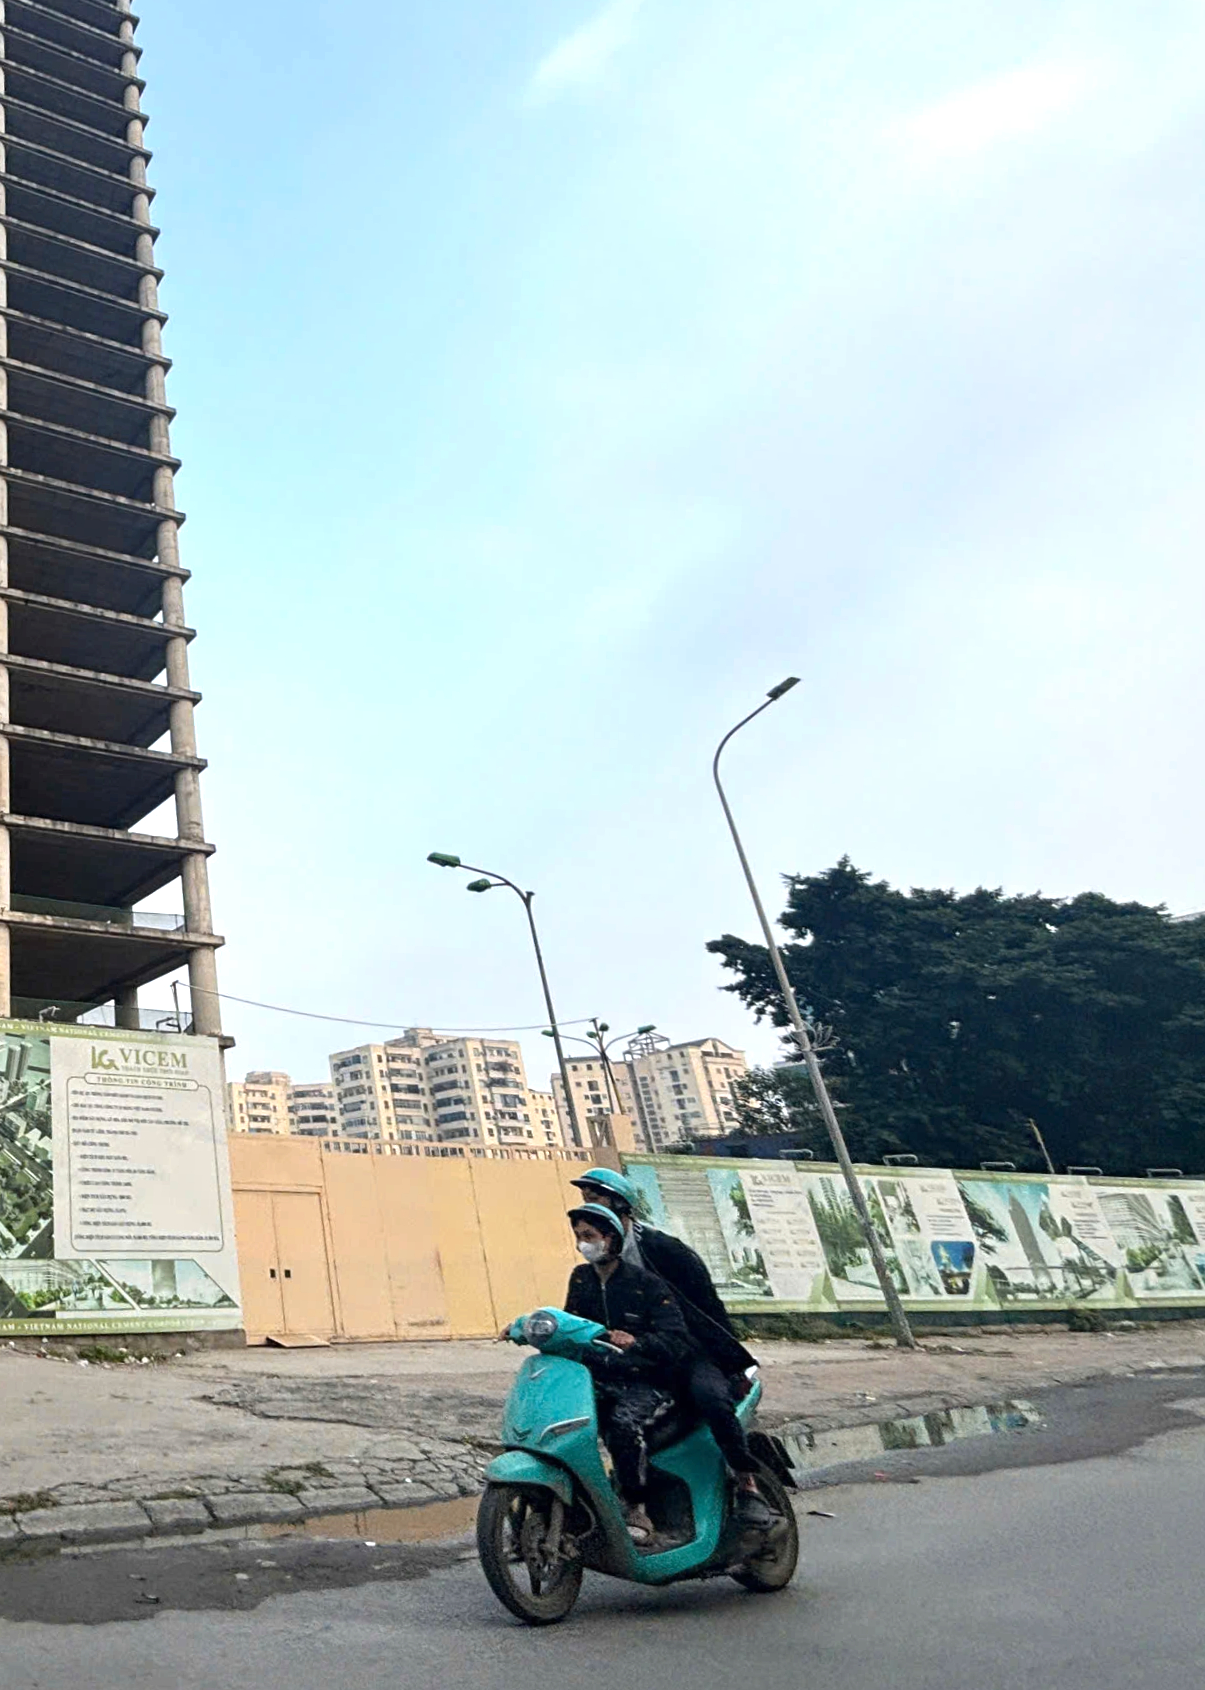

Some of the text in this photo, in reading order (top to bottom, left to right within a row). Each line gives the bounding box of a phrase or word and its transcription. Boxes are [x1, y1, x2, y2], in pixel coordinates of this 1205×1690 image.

[21, 1024, 58, 1033] VIETNAM
[118, 1047, 188, 1068] VICEM
[24, 1322, 64, 1331] VIETNAM
[67, 1321, 108, 1330] NATIONAL
